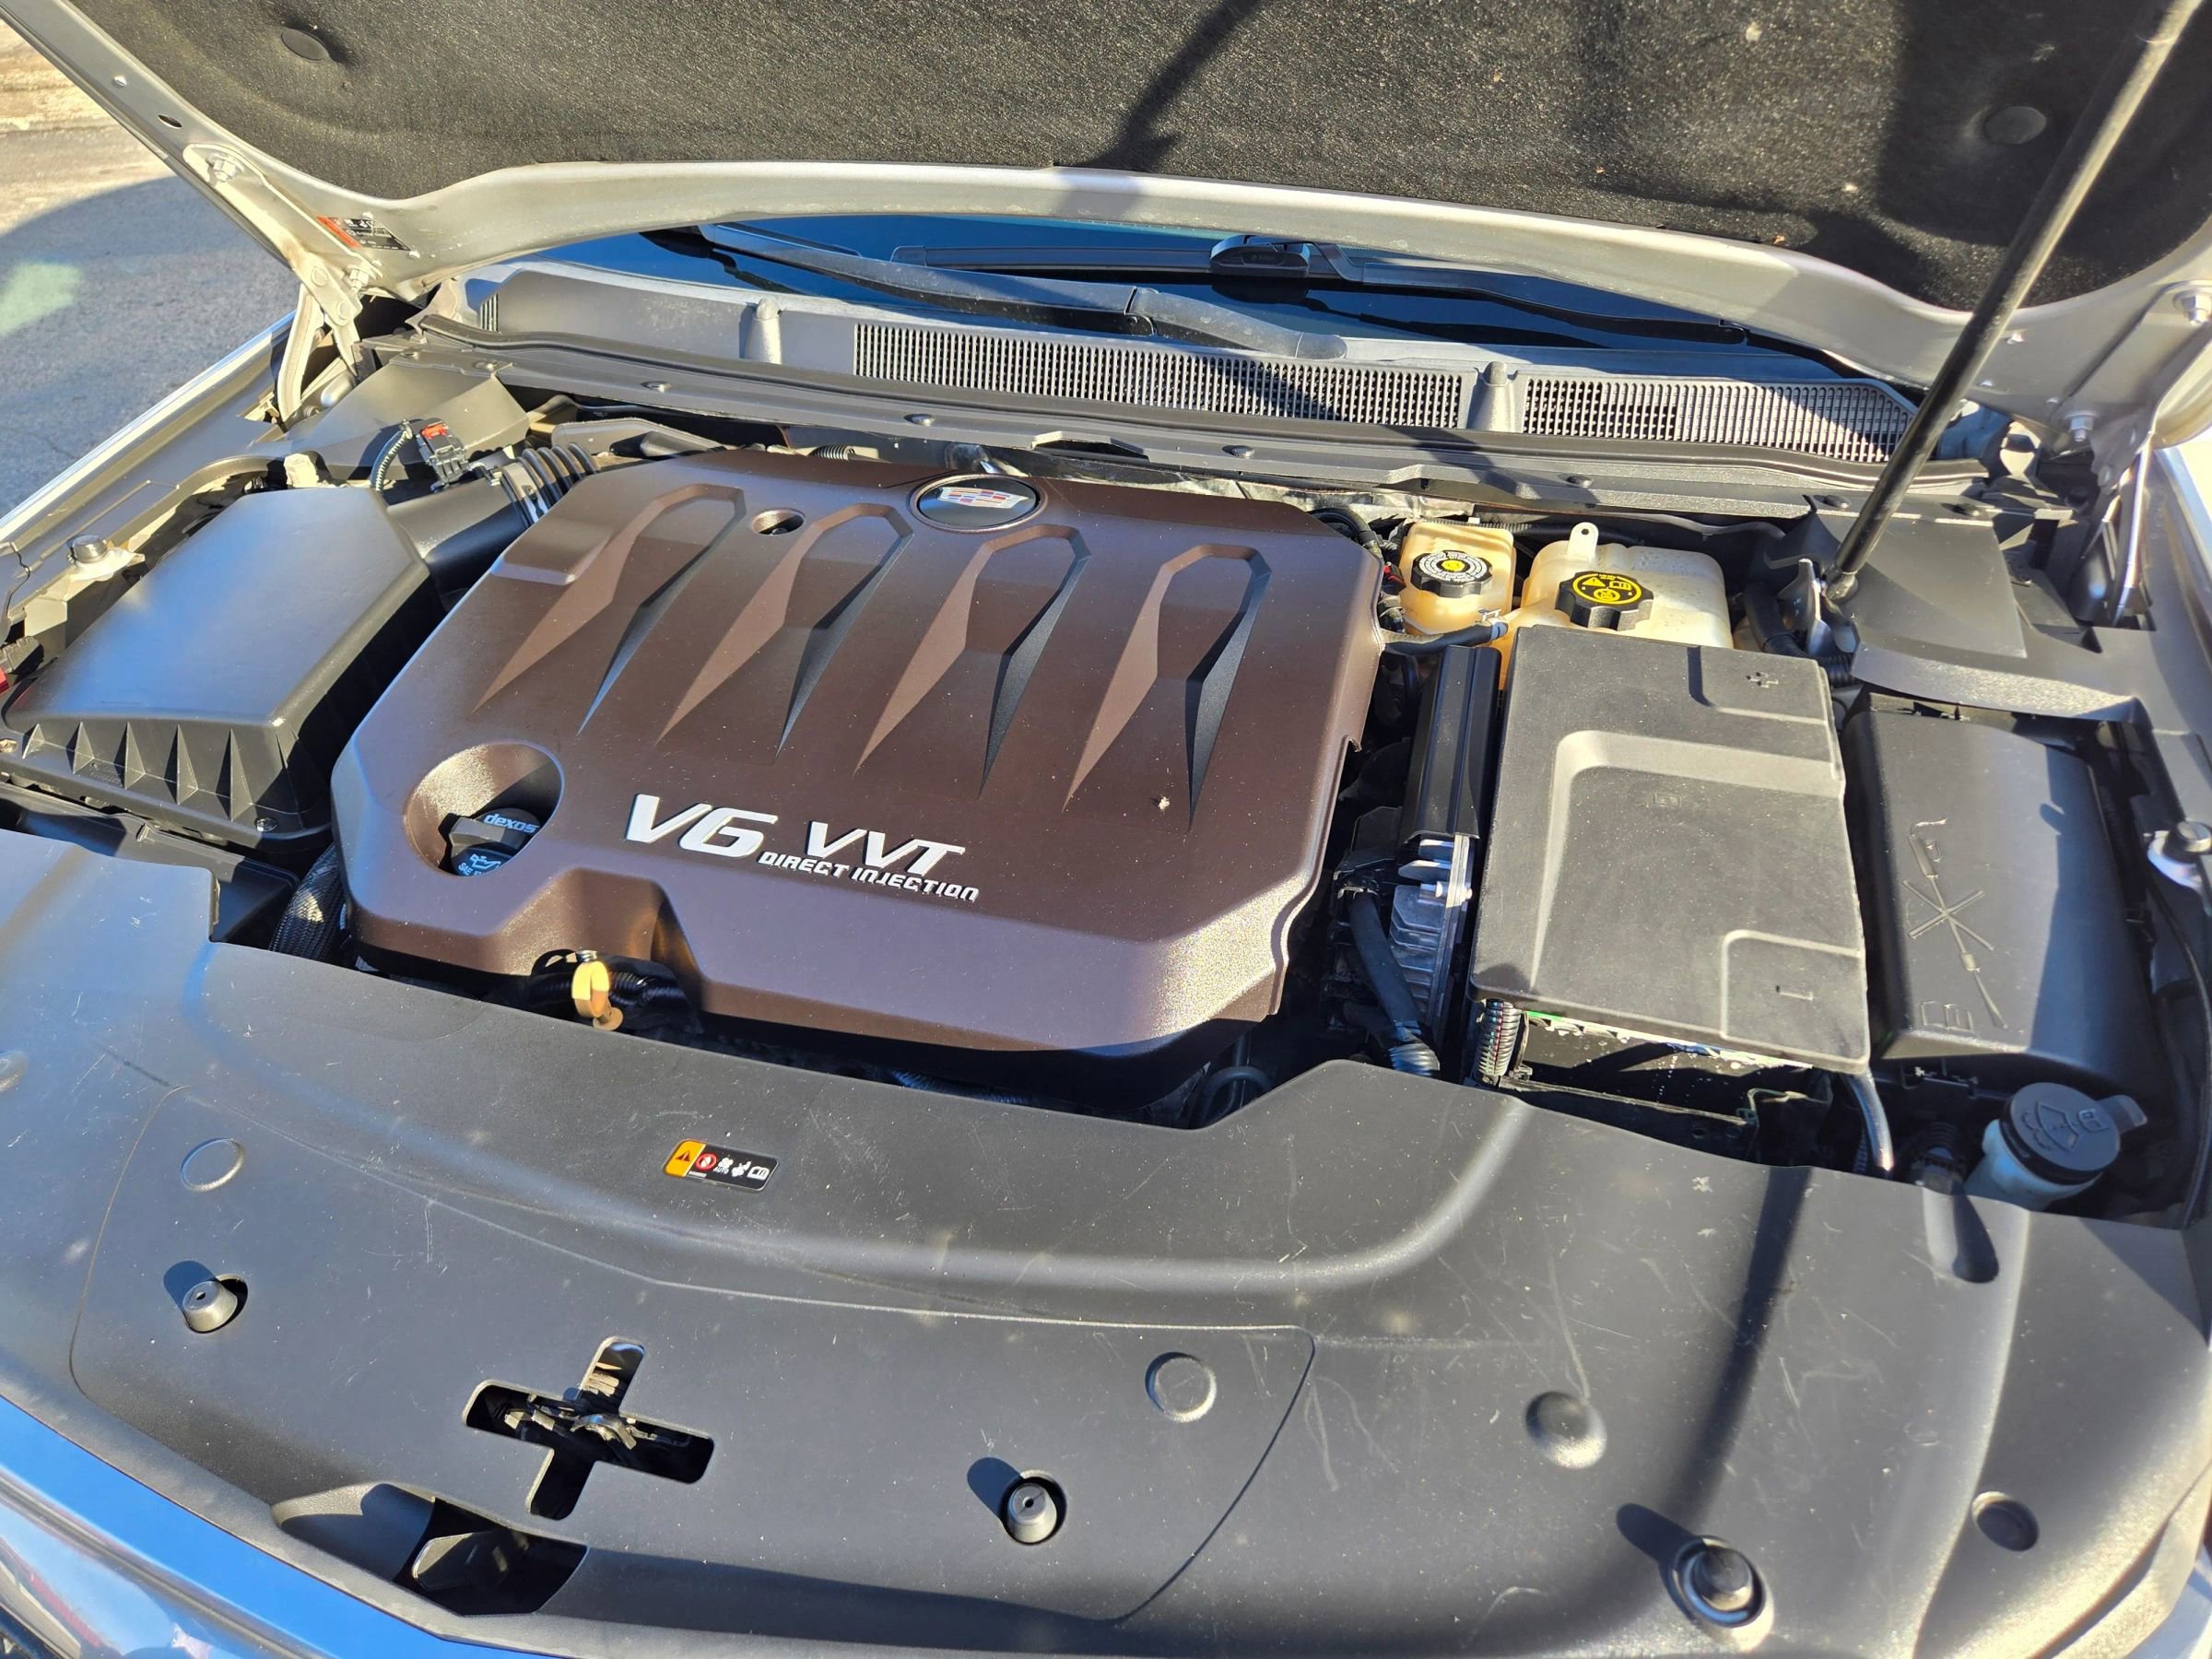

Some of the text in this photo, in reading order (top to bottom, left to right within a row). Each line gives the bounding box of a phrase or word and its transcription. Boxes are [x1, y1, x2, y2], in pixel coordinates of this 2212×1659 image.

[484, 813, 540, 833] dexos
[626, 794, 966, 877] V6 VVT
[458, 862, 474, 876] SAE
[758, 851, 979, 902] DIRECT INJECTION
